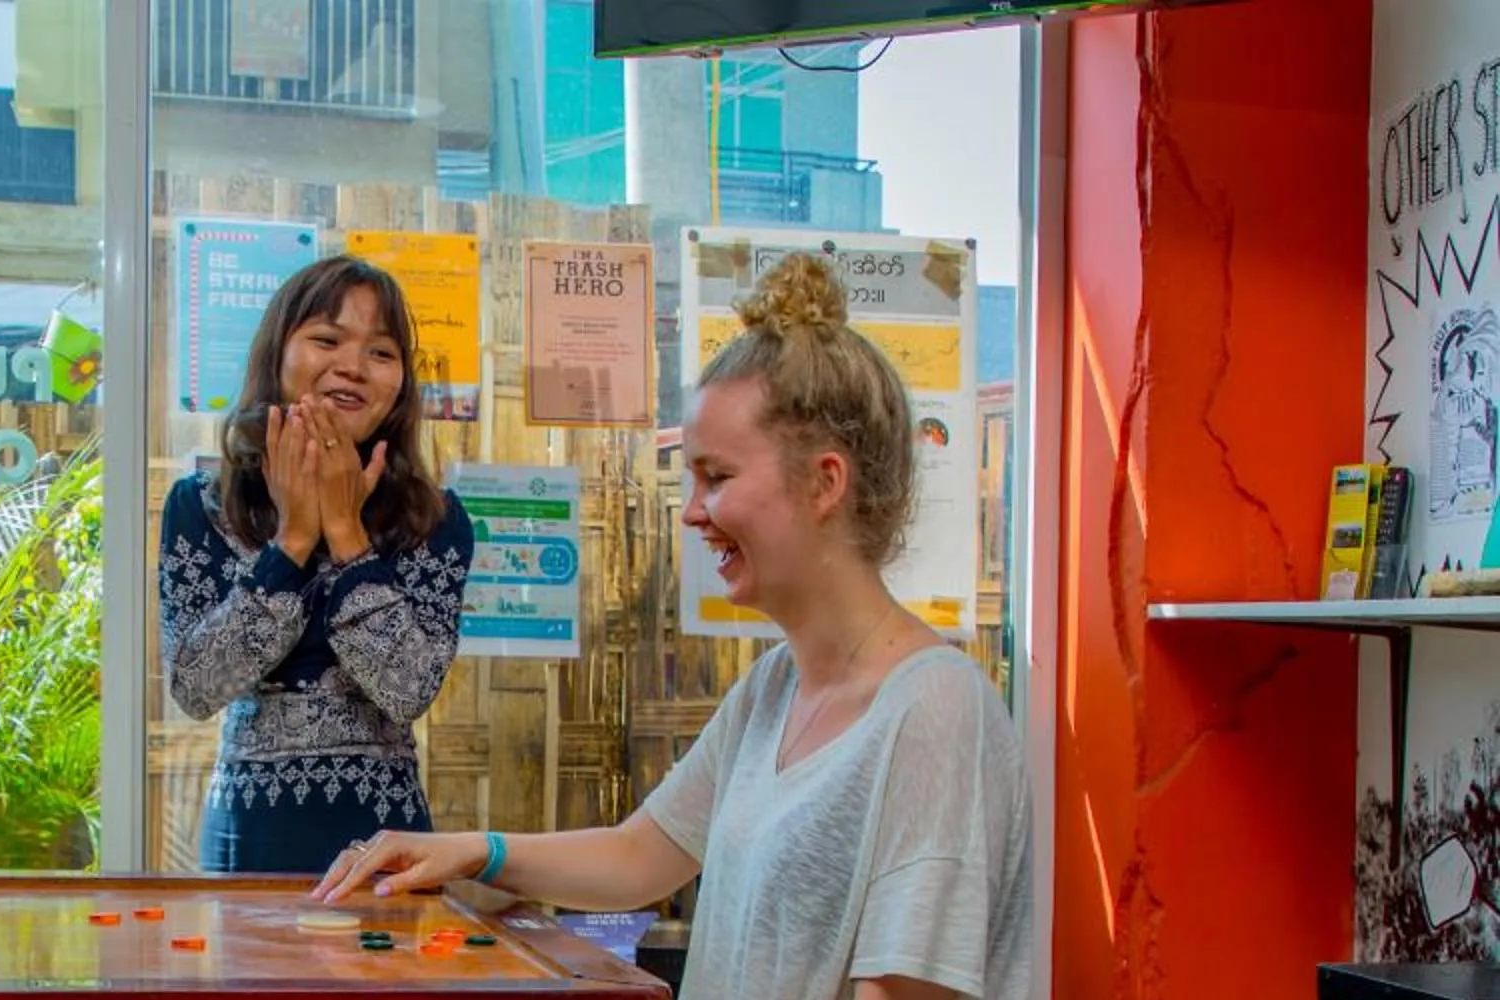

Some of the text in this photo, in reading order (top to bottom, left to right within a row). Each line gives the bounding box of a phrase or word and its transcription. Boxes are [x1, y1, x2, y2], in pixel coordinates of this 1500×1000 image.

[1383, 79, 1468, 225] OTHER
[208, 251, 240, 269] BE
[554, 260, 623, 278] TRASH
[553, 278, 624, 297] HERO
